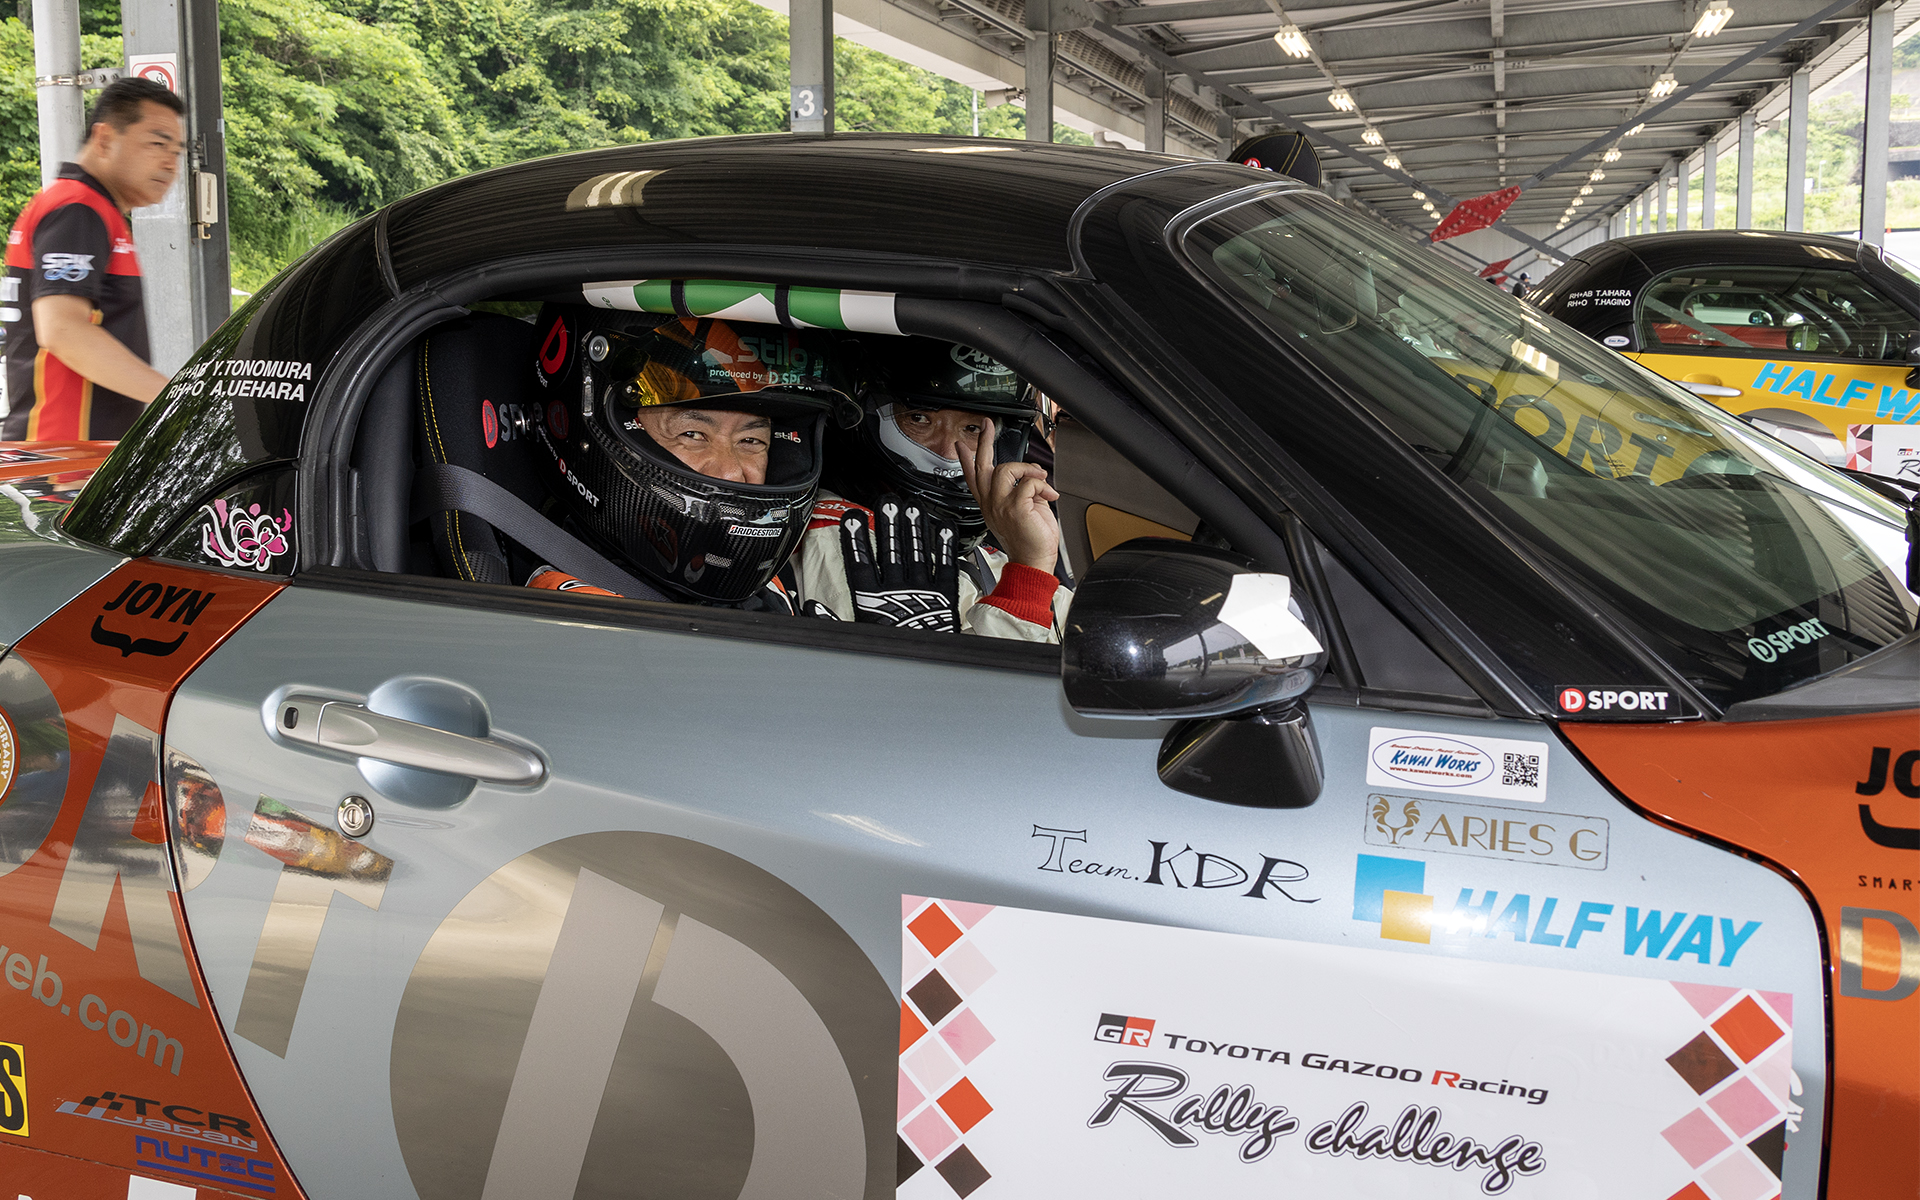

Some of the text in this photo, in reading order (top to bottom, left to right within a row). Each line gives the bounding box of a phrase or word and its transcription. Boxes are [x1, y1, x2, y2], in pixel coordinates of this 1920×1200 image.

[798, 89, 815, 117] 3
[1567, 298, 1631, 308] RH+O T.HAGINO
[1568, 290, 1593, 300] RH+AB
[212, 359, 312, 381] Y.TONOMURA
[709, 368, 751, 379] produced
[752, 371, 763, 381] by
[209, 379, 305, 402] A.UEHARA
[1750, 361, 1876, 409] HALF
[566, 469, 601, 508] SPORT
[729, 525, 780, 537] BRIDGESTONE
[102, 578, 217, 628] JOYN
[1771, 617, 1831, 655] SPORT
[1587, 690, 1669, 711] SPORT
[1389, 749, 1433, 767] KAWAI
[1434, 753, 1482, 772] WORKS
[1389, 766, 1473, 779] www.kawaiworks.com
[1423, 818, 1602, 862] ARIES G
[1858, 874, 1920, 891] SMAR
[1444, 887, 1763, 968] HALF WAY
[1095, 1018, 1550, 1106] GR TOYOTA GAZOO Racing
[118, 1093, 256, 1139] TCR
[1087, 1060, 1547, 1197] Rally challenge
